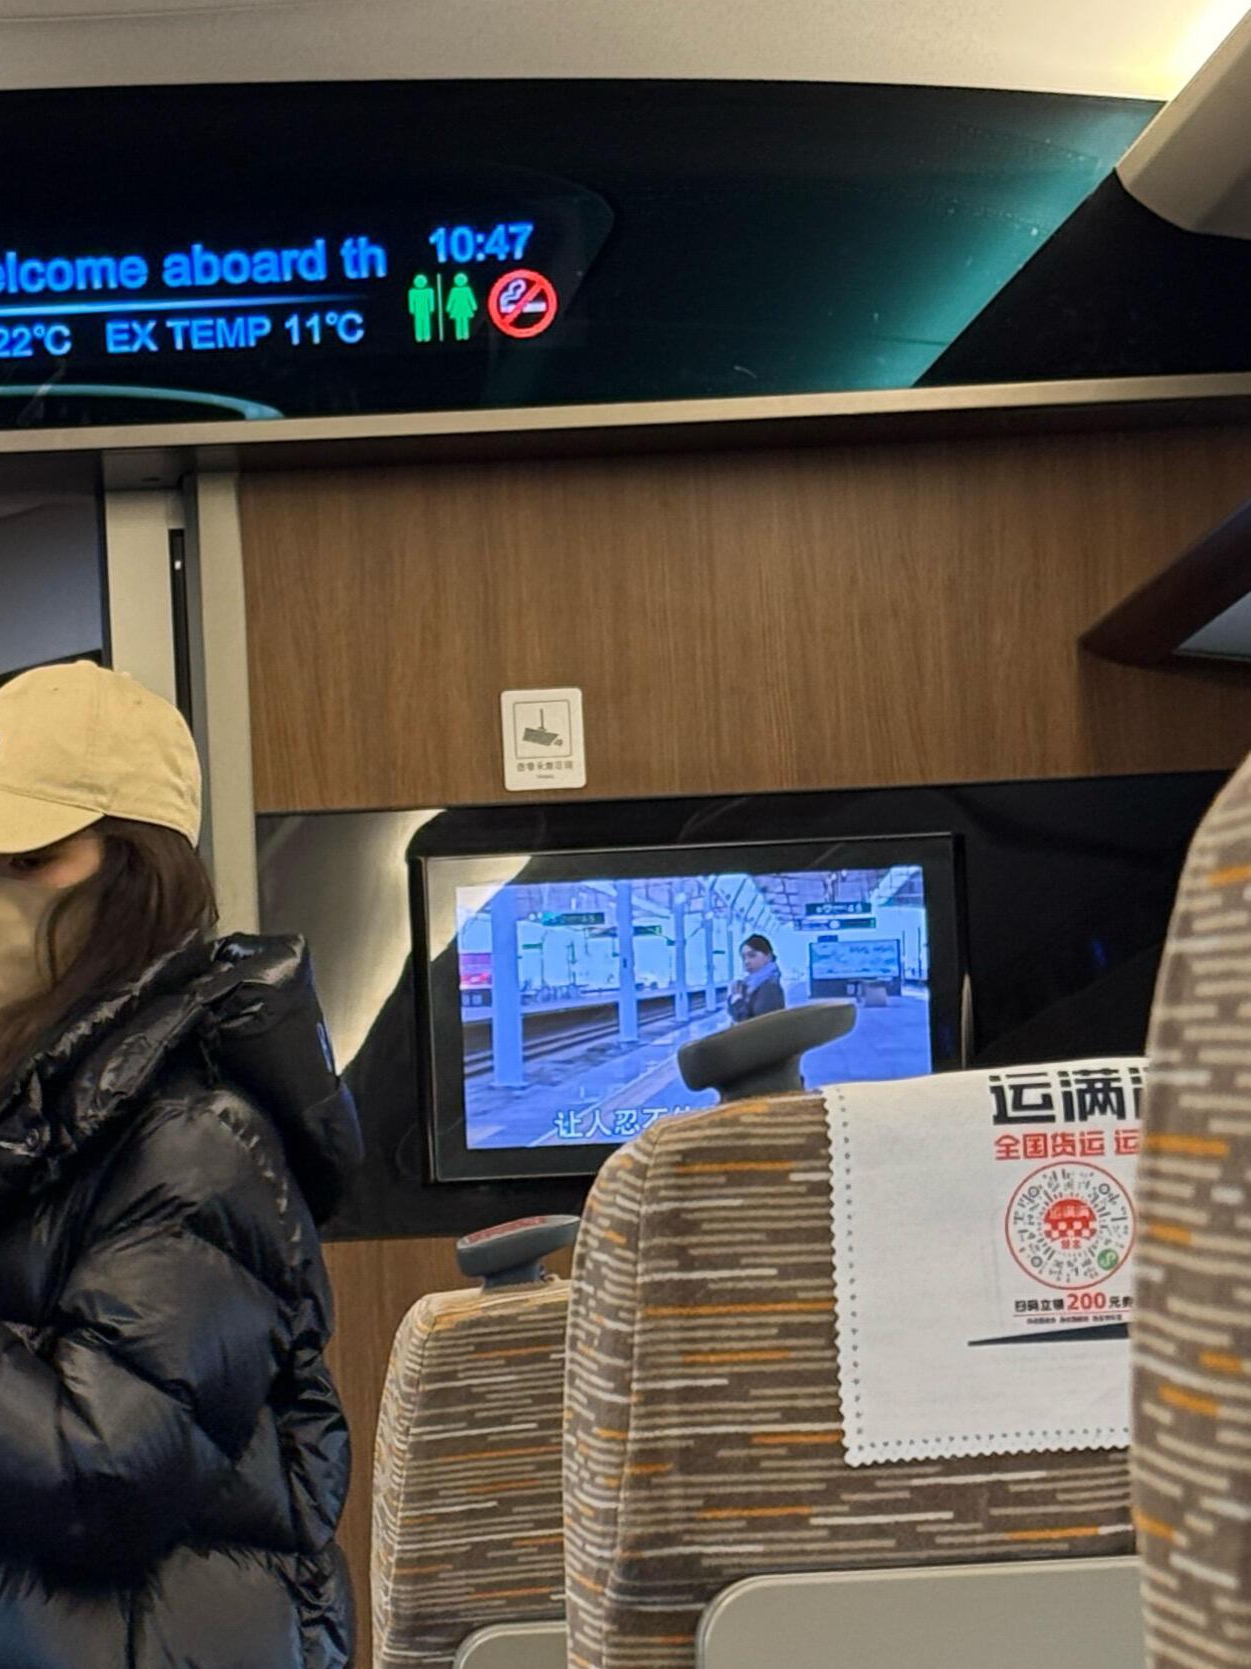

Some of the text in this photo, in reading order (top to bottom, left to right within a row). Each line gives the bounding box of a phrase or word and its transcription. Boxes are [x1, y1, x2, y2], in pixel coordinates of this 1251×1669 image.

[162, 238, 327, 287] aboard
[340, 236, 387, 279] th
[429, 221, 534, 263] 10:47
[106, 319, 158, 353] EX
[166, 314, 271, 350] TEMP
[994, 1131, 1105, 1160] 全国货运
